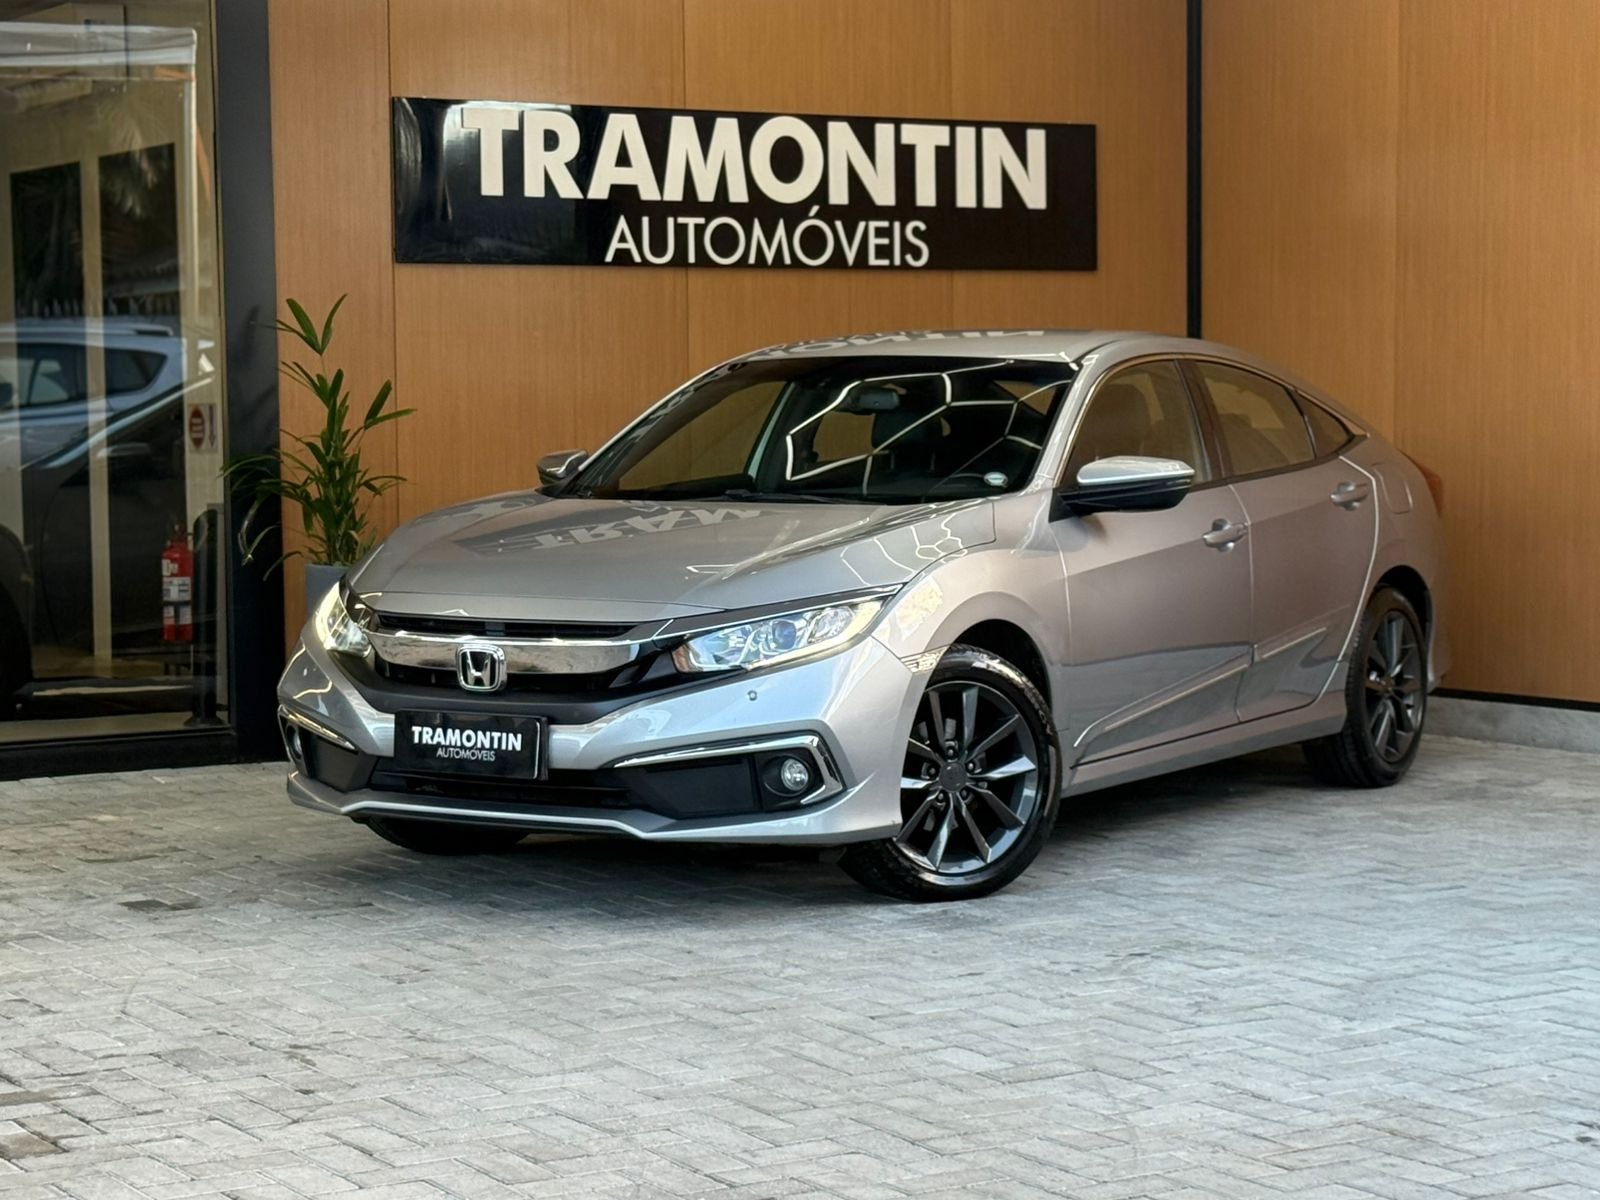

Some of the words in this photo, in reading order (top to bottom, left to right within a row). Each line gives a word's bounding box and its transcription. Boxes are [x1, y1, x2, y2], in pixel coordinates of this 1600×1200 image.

[461, 107, 1048, 210] TRAMONTIN
[604, 205, 931, 268] AUTOMÓVEIS
[411, 725, 523, 752] TRAMONTIN
[436, 746, 497, 762] AUTOMÓVEIS
